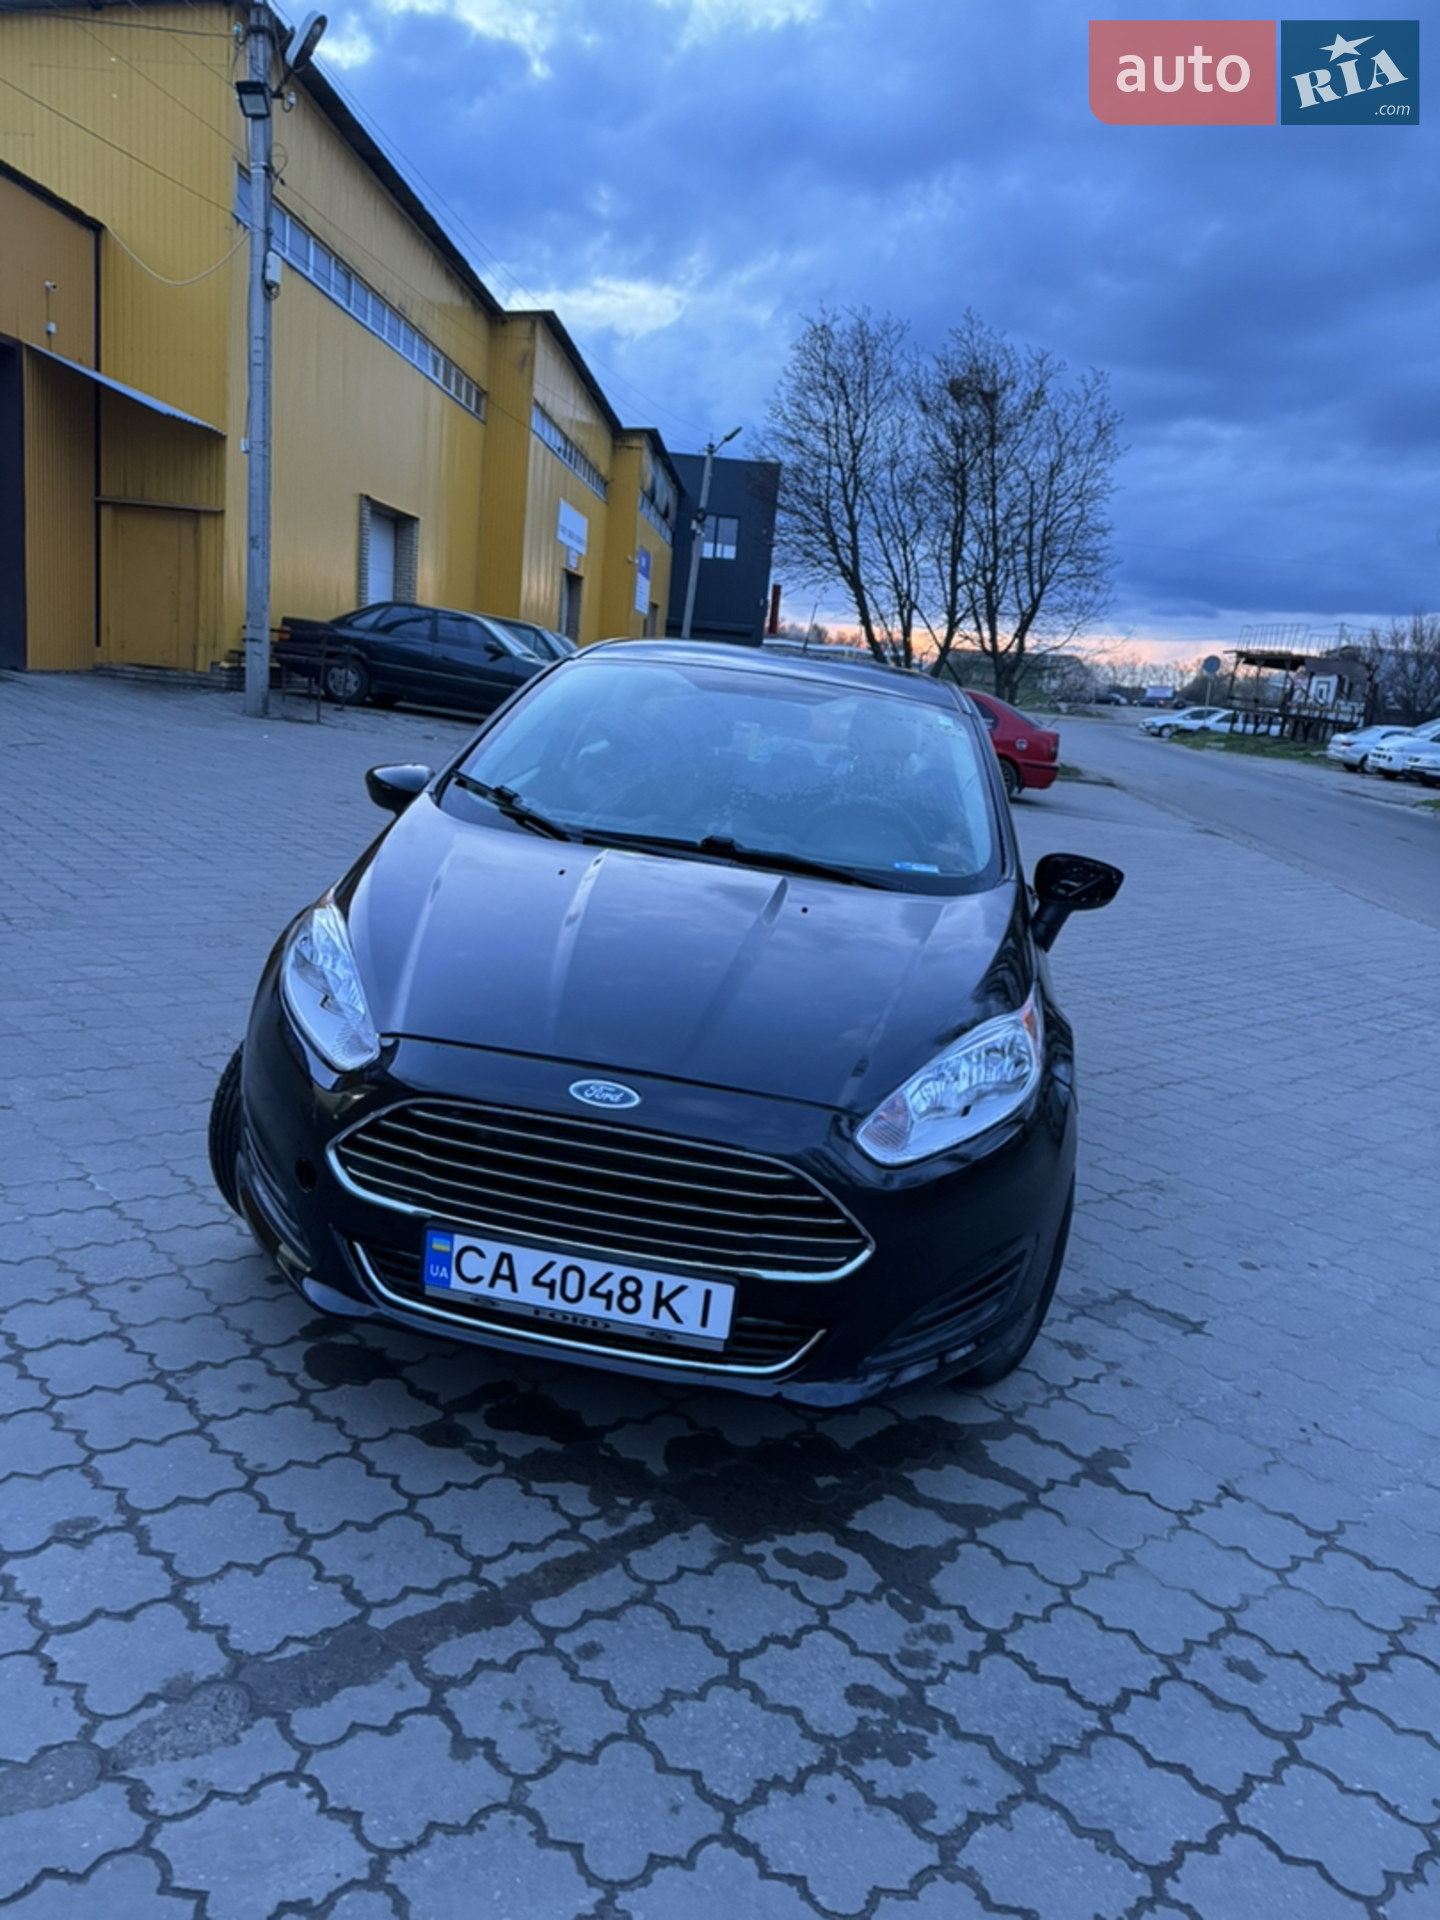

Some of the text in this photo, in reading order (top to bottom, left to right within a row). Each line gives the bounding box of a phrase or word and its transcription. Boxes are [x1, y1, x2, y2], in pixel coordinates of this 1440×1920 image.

[584, 1084, 624, 1103] Ford
[429, 1264, 449, 1280] UA
[454, 1245, 713, 1328] CA 4048 KI
